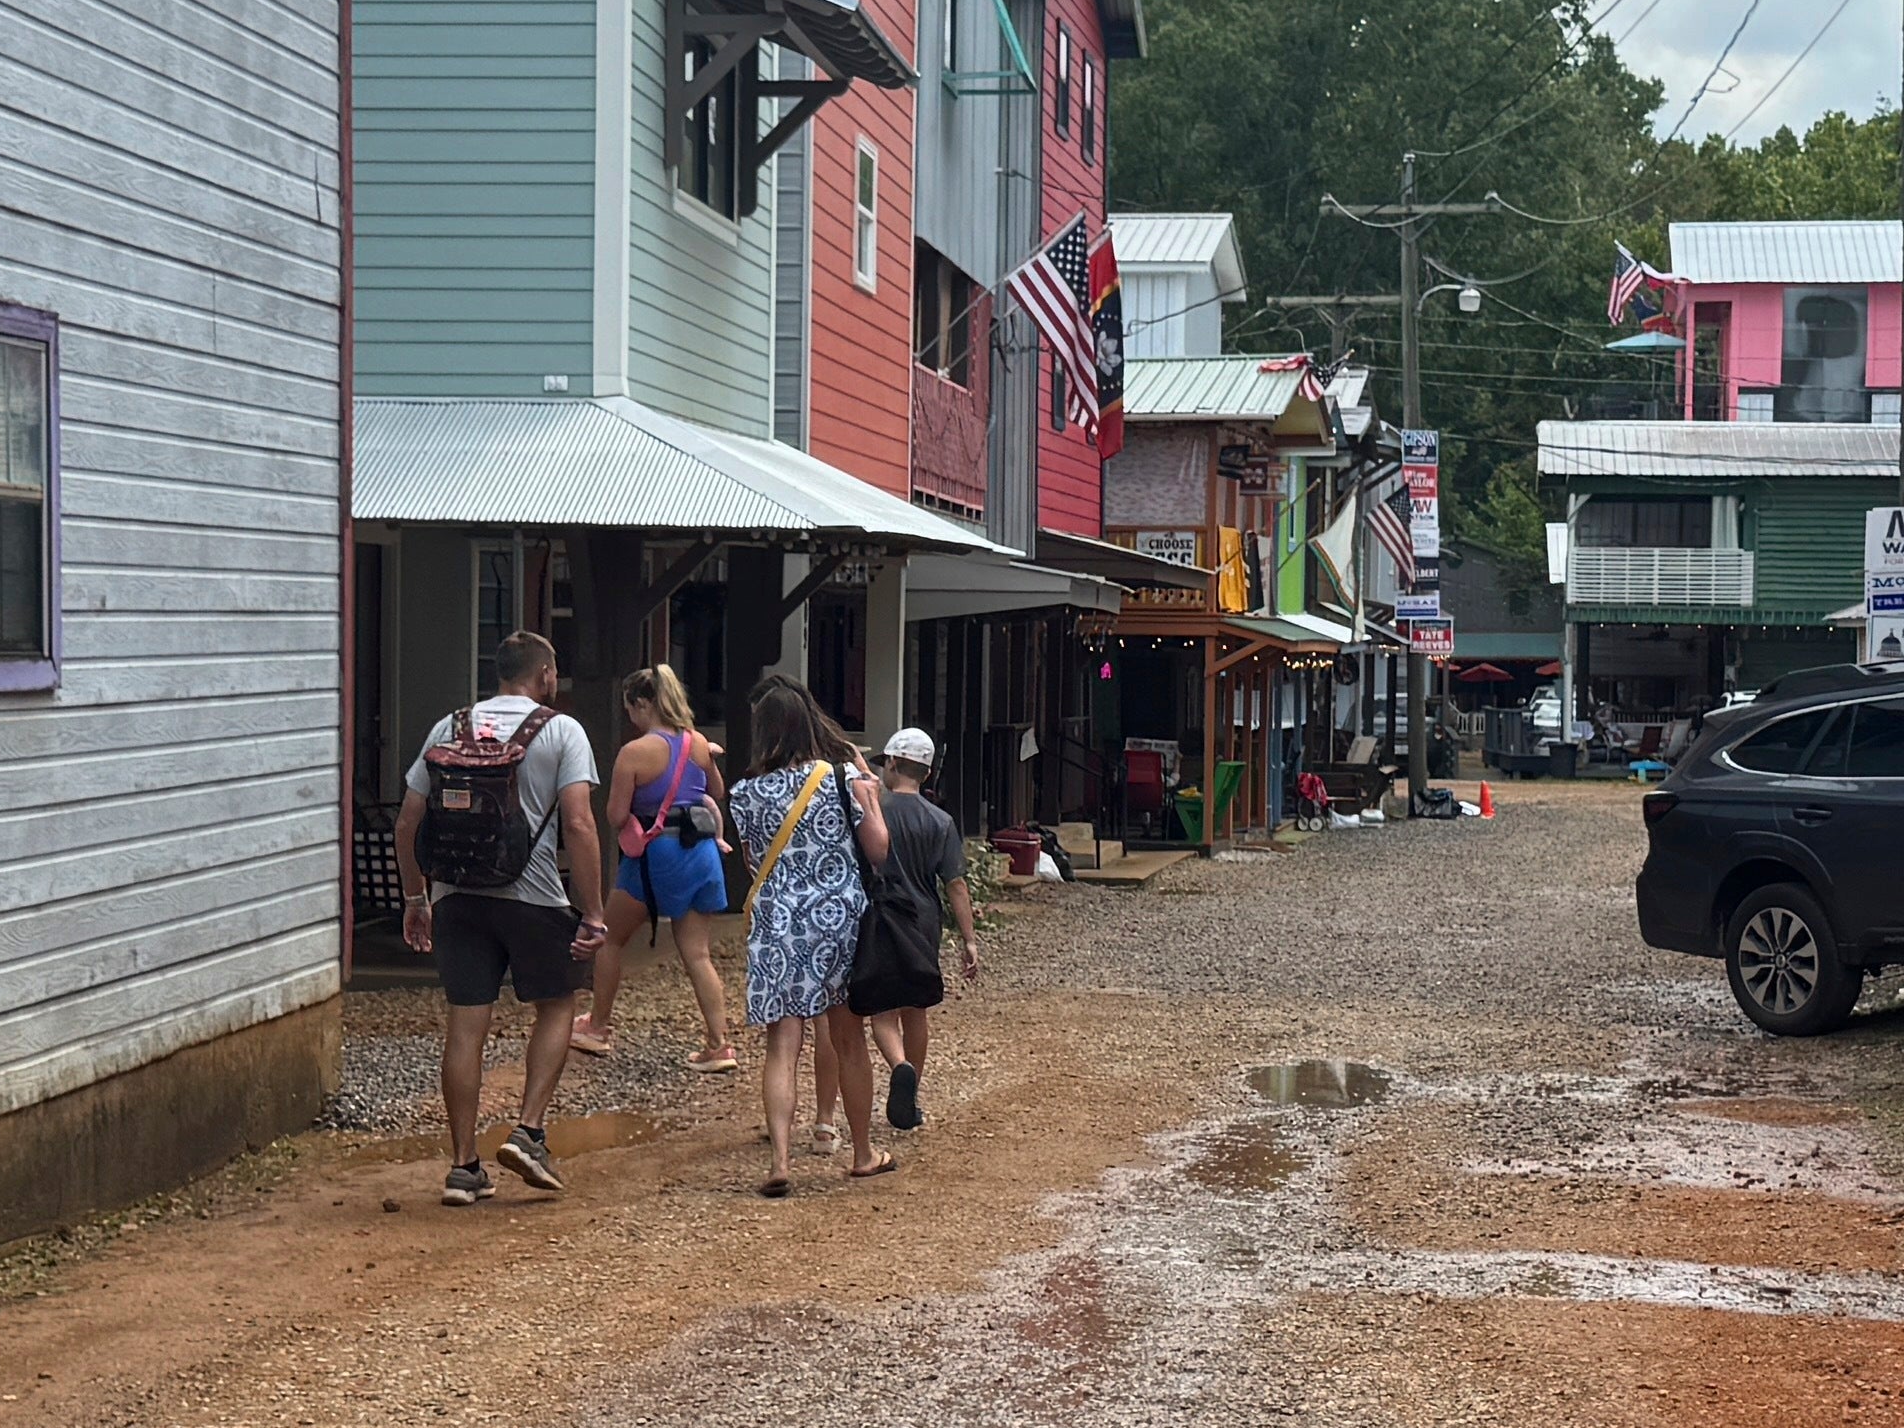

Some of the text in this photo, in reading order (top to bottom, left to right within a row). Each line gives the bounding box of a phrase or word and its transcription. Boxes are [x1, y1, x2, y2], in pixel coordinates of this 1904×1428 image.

[1149, 538, 1193, 550] CHOOSE
[1419, 630, 1445, 640] TATE
[1412, 641, 1451, 651] REEVES
